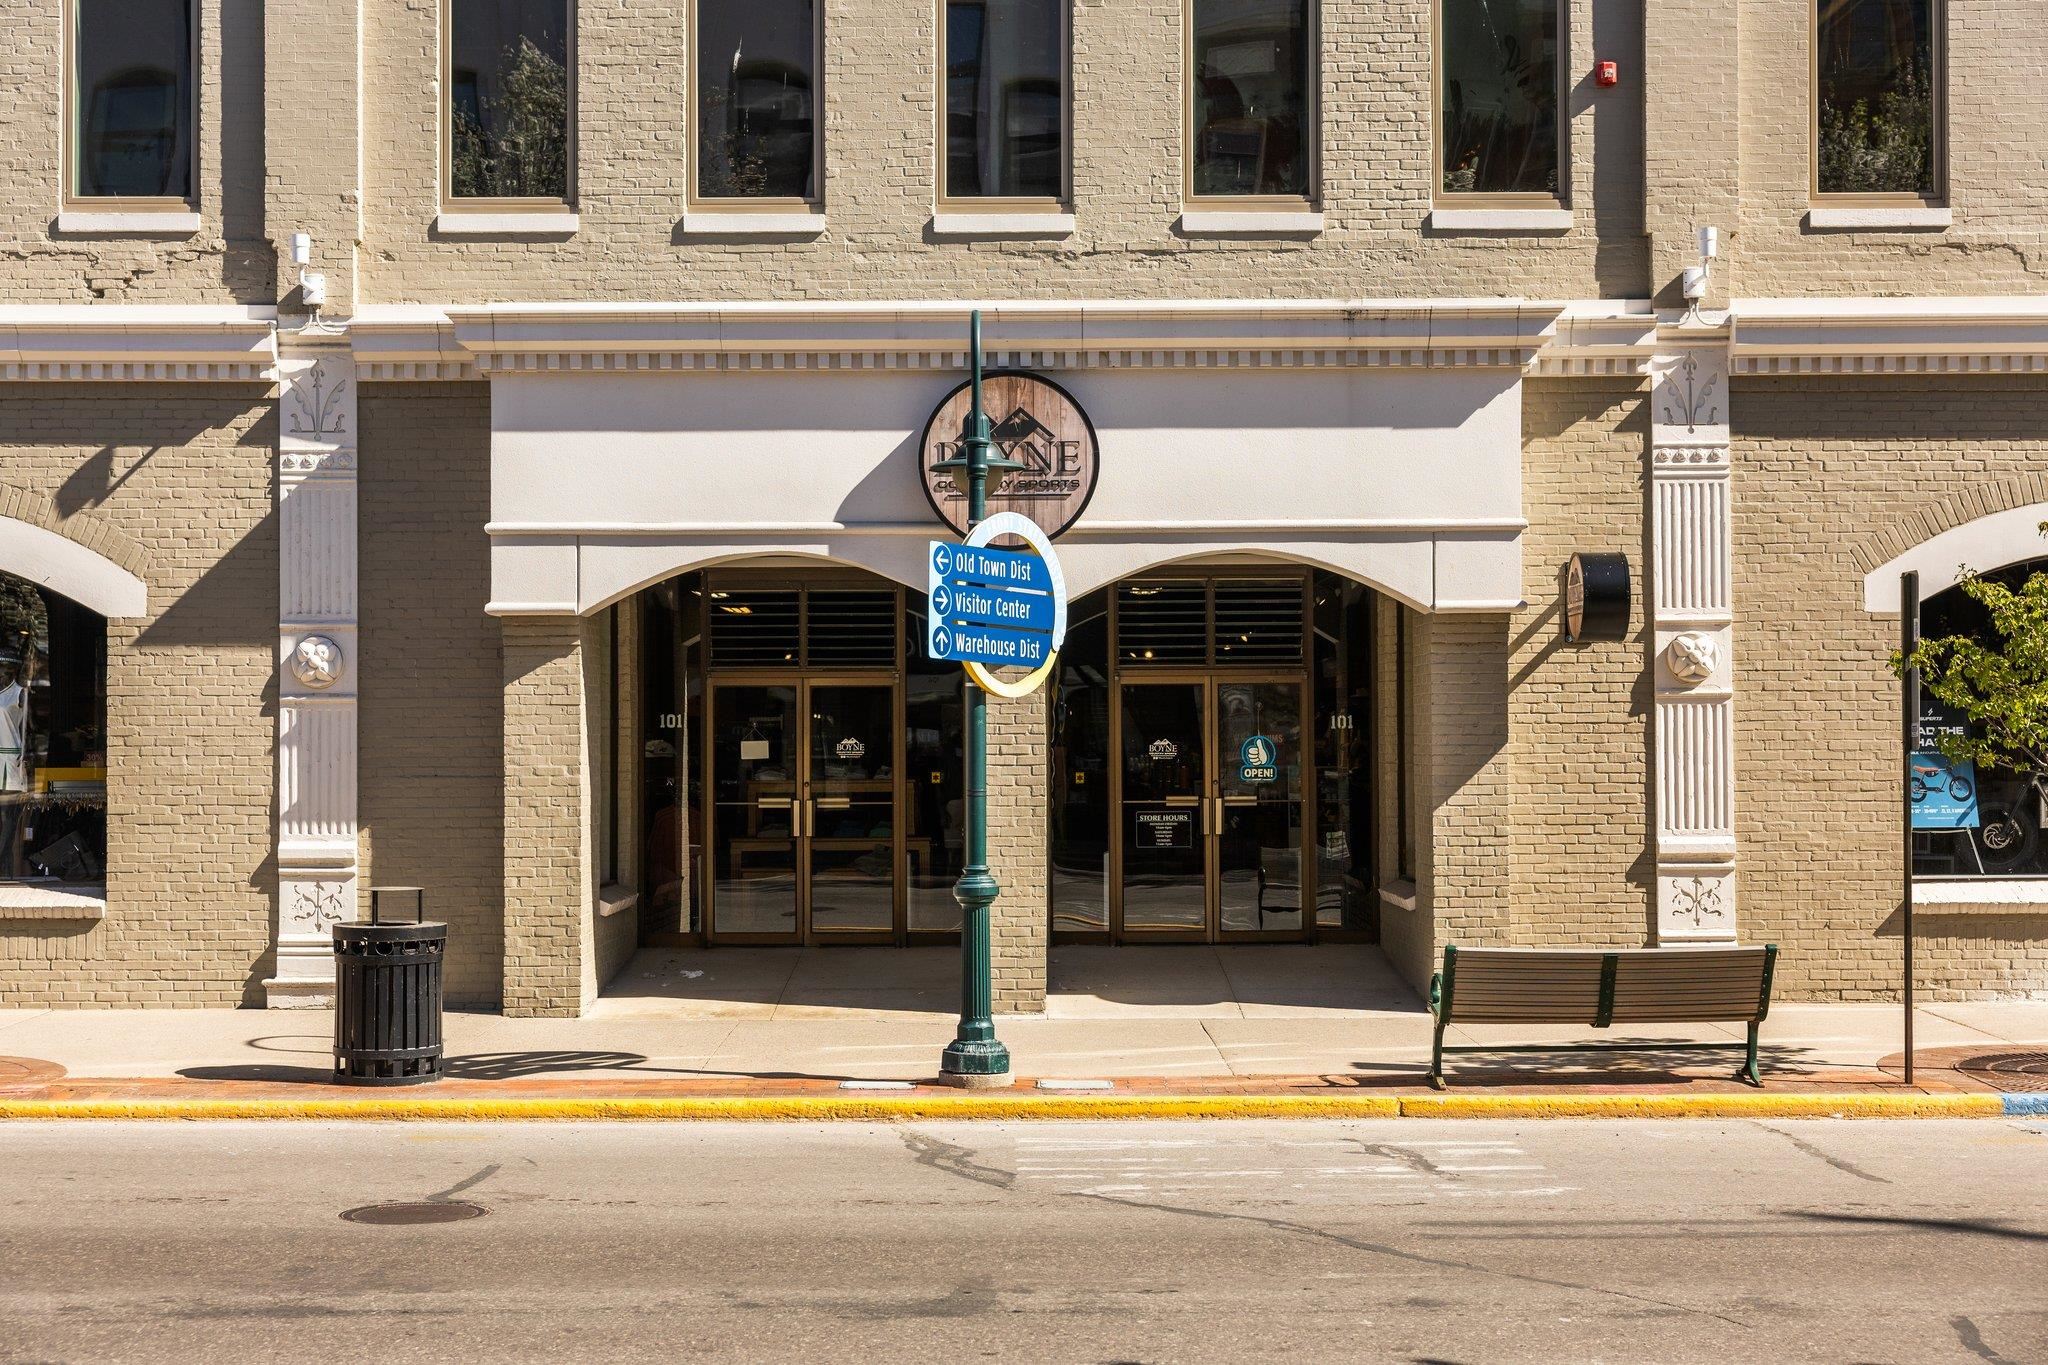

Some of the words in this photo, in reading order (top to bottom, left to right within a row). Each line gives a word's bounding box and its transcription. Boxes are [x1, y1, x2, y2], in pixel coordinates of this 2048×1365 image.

[1016, 480, 1080, 491] SPORTS
[956, 552, 975, 574] Old
[979, 556, 1006, 578] Town
[1010, 560, 1031, 581] Dist
[955, 593, 992, 615] Visitor
[996, 595, 1031, 619] Center
[955, 633, 1016, 657] Warehouse
[1020, 638, 1040, 660] Dist
[660, 714, 682, 728] 101
[1331, 715, 1353, 729] 101
[1919, 726, 1935, 735] AD
[1938, 726, 1964, 735] THE
[1244, 768, 1273, 778] OPEN!
